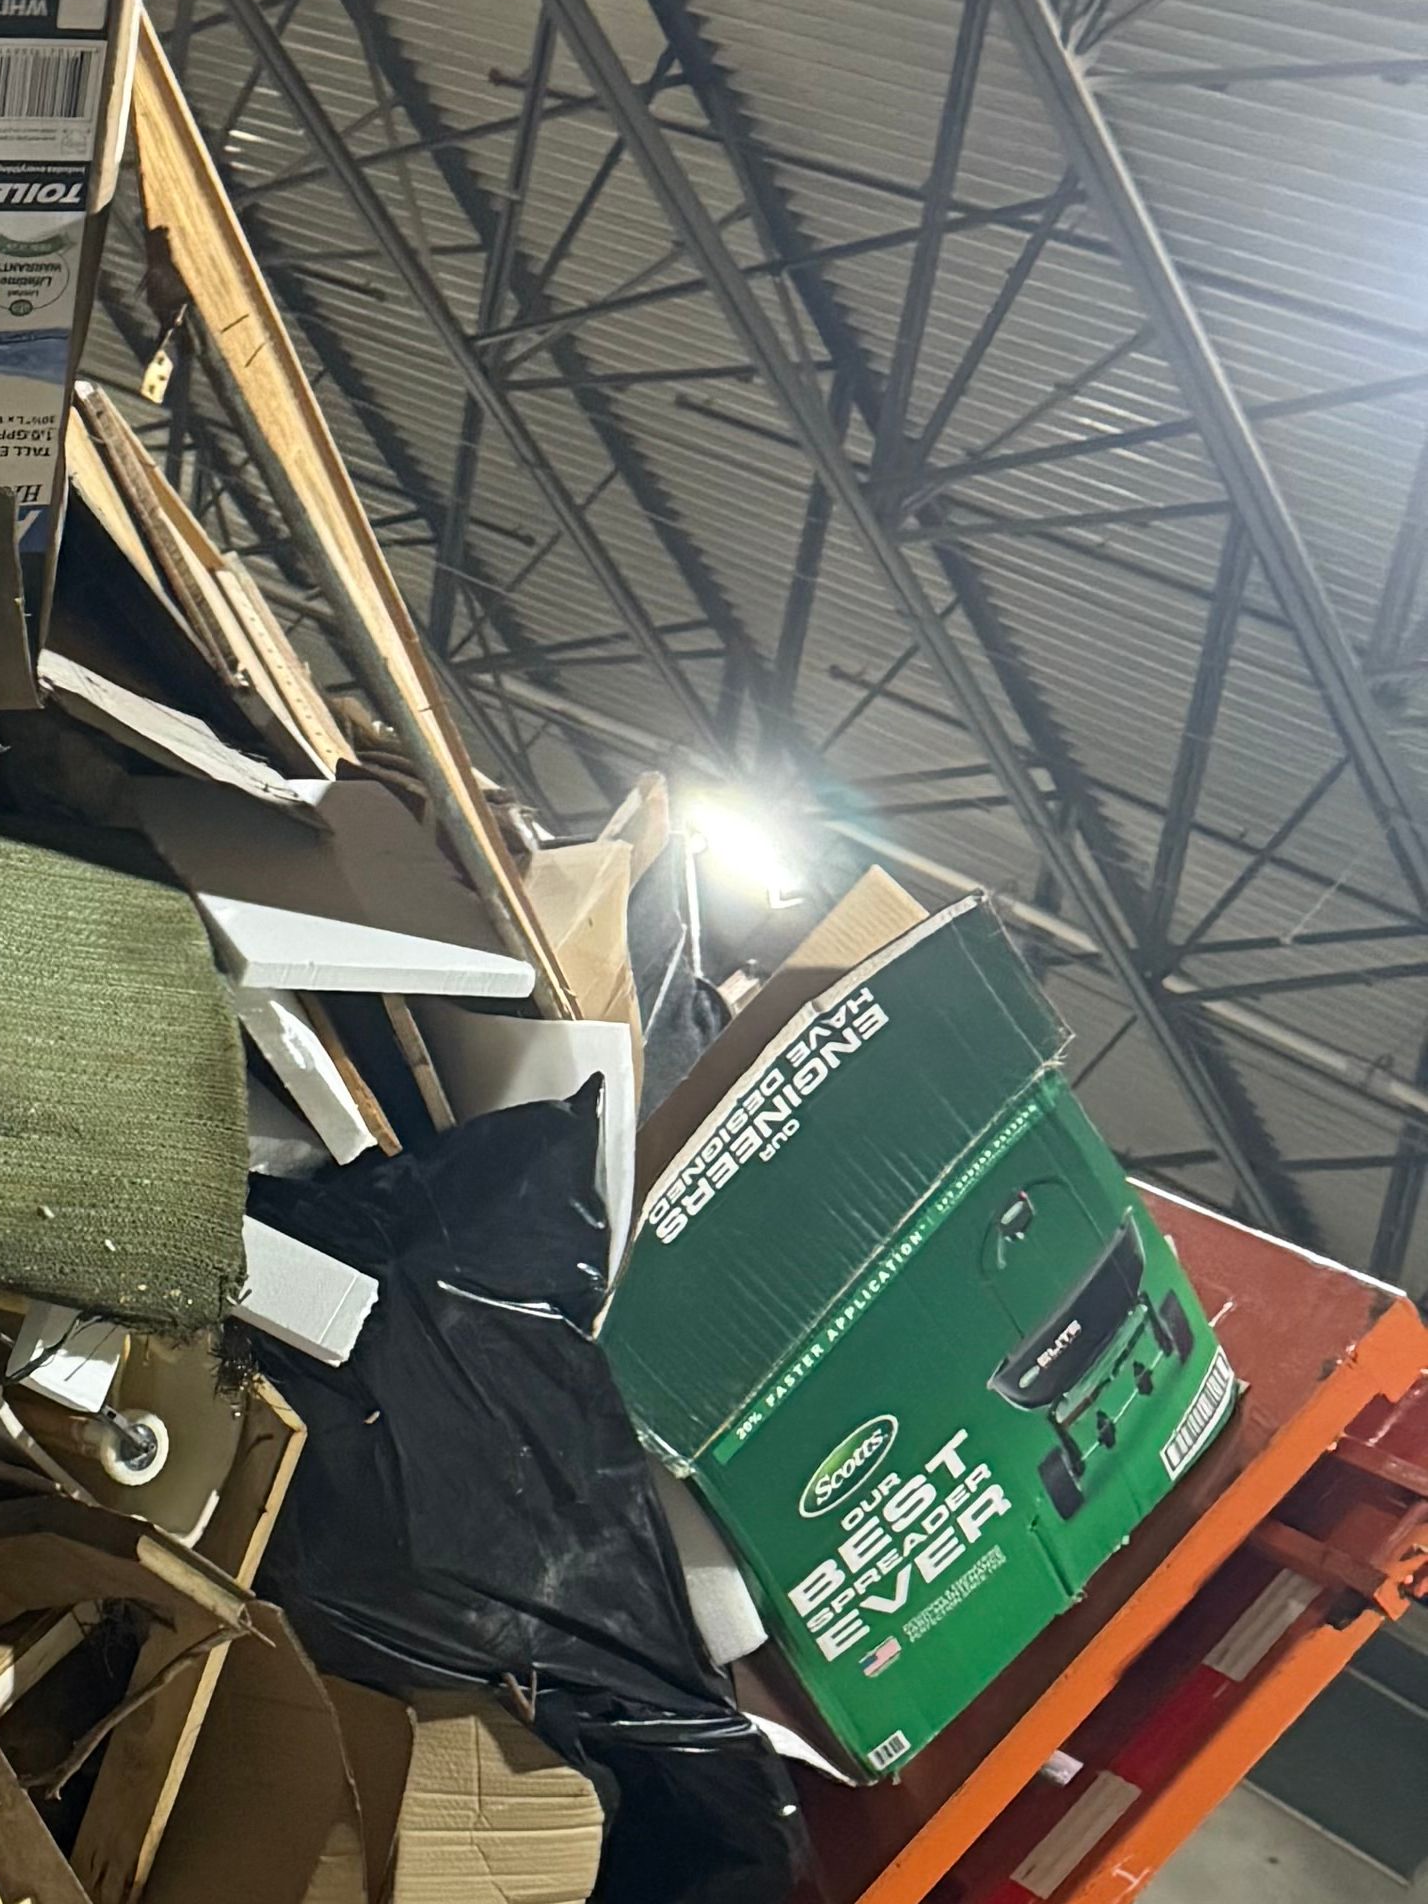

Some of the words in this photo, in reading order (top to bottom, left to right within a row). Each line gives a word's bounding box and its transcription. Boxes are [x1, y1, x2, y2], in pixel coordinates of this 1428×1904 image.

[12, 446, 51, 457] TALL
[785, 987, 874, 1068] HAVE
[648, 1067, 785, 1225] DESIGNED
[655, 1003, 890, 1244] ENGINEERS
[758, 1110, 800, 1162] OUR
[735, 1412, 763, 1440] 20%
[765, 1343, 825, 1408] FASTER
[814, 1428, 888, 1506] Scotts
[841, 1472, 902, 1531] OUR
[787, 1428, 968, 1617] BEST
[806, 1463, 992, 1633] SPREADER
[815, 1484, 1012, 1662] EVER
